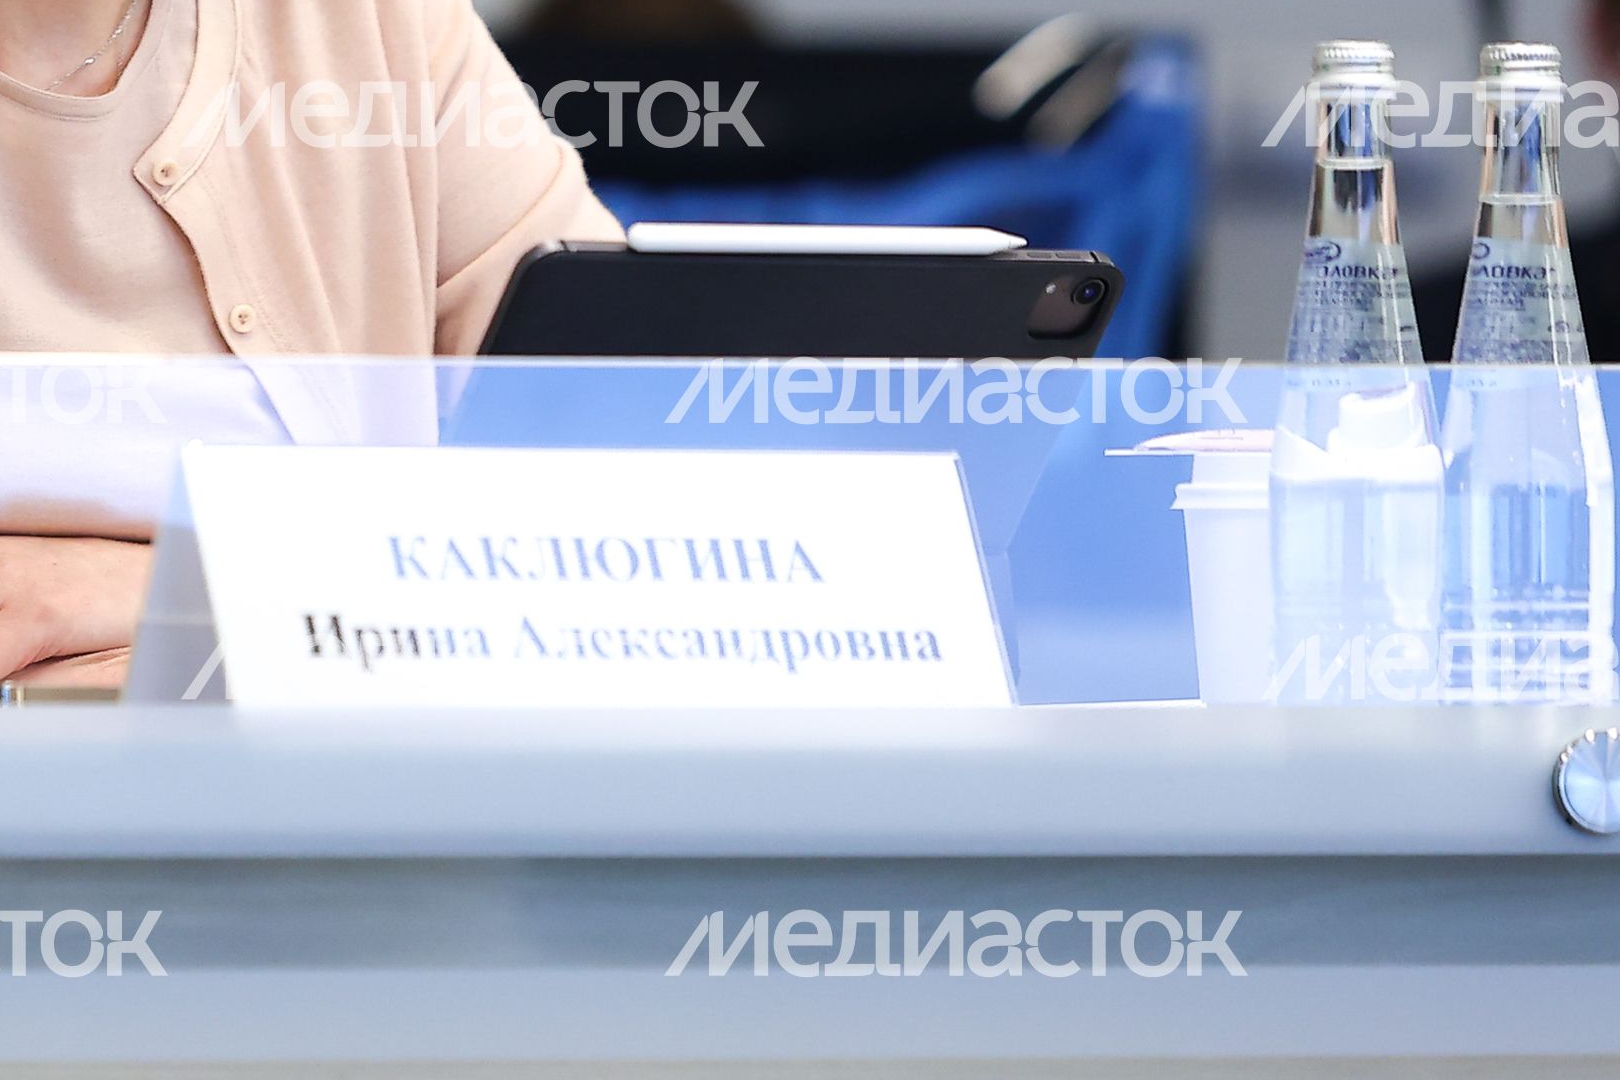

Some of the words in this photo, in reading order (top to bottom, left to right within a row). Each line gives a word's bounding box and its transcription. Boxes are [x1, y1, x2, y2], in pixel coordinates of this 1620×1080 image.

[387, 533, 827, 584] КАКЛЮГИНА
[300, 609, 492, 675] Ирина
[515, 614, 944, 675] Александровна
